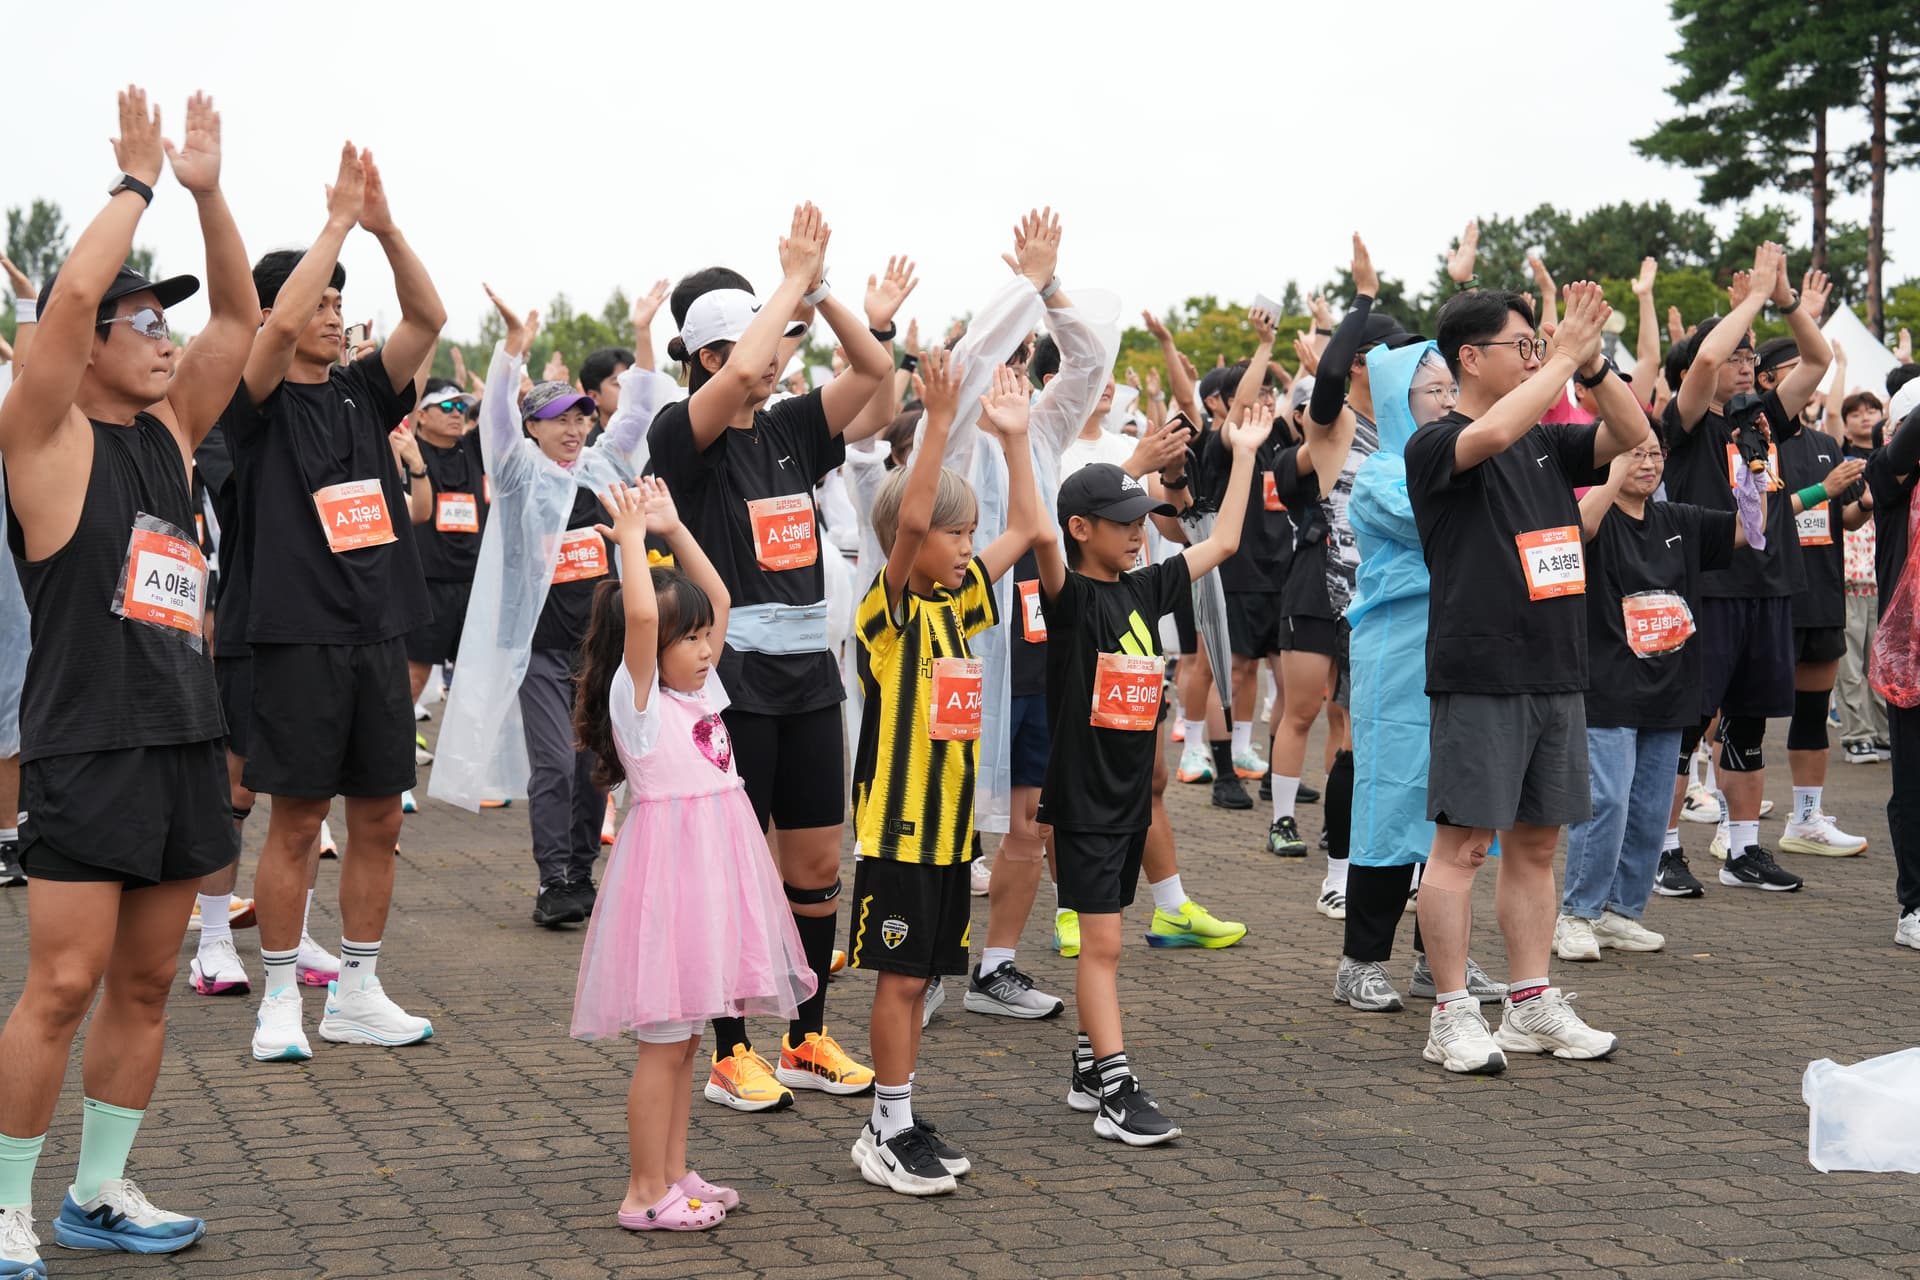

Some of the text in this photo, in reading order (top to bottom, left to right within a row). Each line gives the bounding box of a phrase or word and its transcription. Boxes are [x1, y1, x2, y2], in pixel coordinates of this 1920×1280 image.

[336, 504, 382, 527] A 지유성
[767, 527, 781, 545] A
[1538, 553, 1580, 574] A 최창민
[145, 569, 198, 602] A 이충섭
[170, 596, 184, 607] 1603
[1637, 619, 1649, 632] B
[946, 691, 963, 710] A
[1107, 684, 1123, 702] A
[793, 1055, 837, 1082] NITRO
